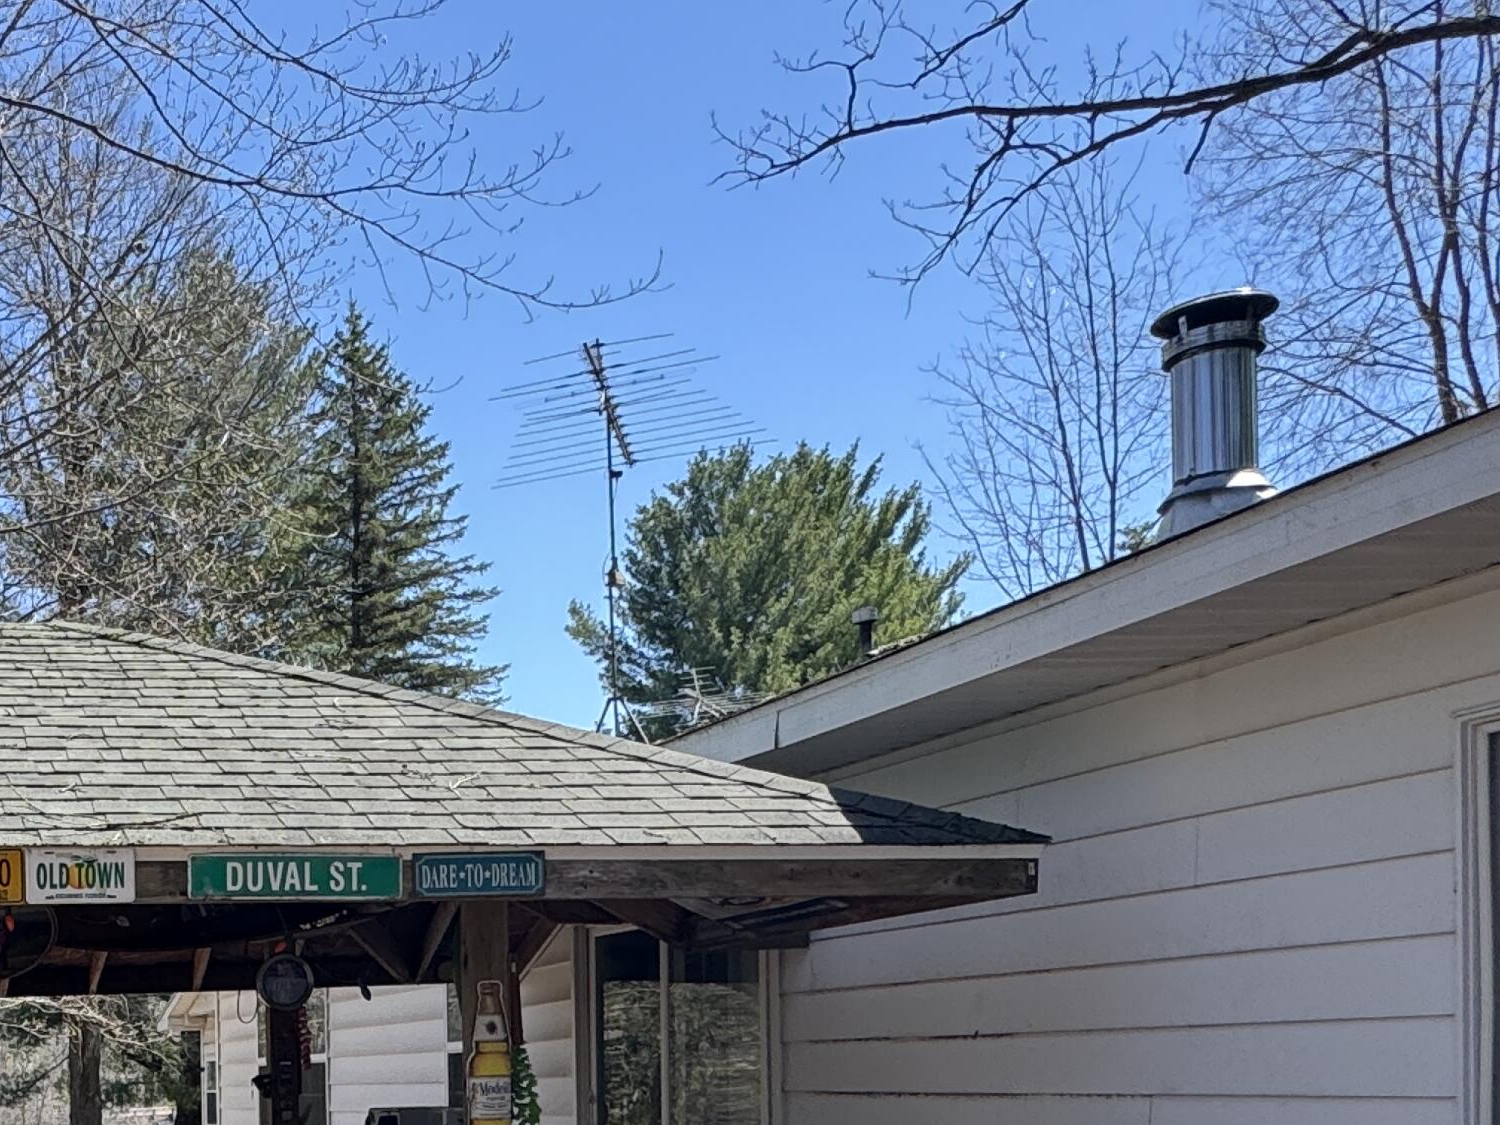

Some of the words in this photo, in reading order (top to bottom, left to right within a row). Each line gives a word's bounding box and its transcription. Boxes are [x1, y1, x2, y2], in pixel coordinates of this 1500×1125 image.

[36, 862, 70, 890] OLD
[74, 862, 125, 889] TOWN
[226, 860, 319, 893] DUVAL
[328, 861, 368, 892] ST.
[420, 863, 458, 889] DARE
[465, 863, 484, 887] TO
[490, 862, 537, 887] DREAM
